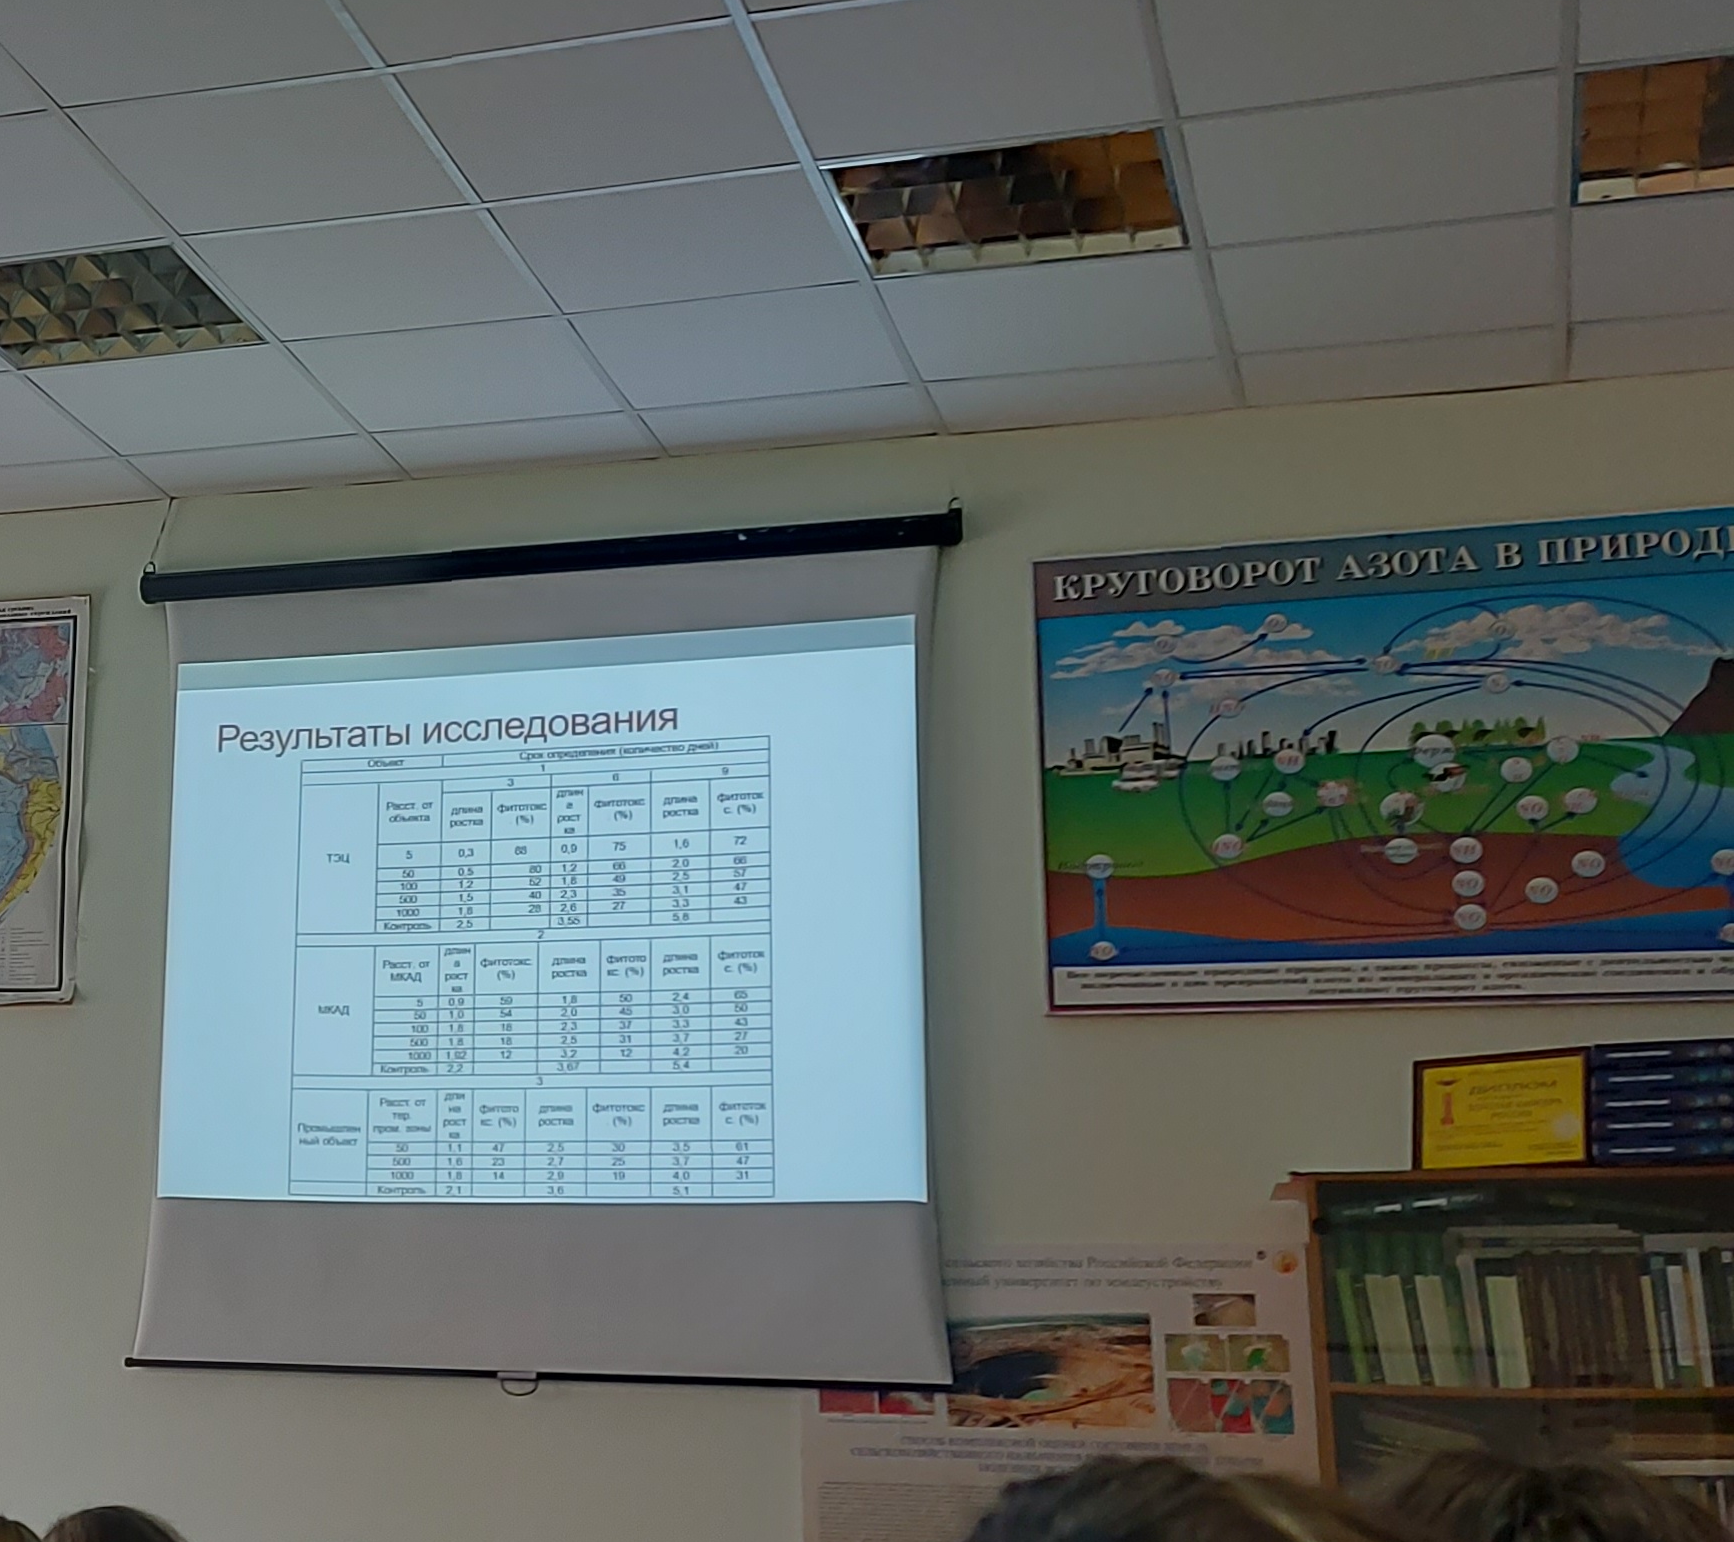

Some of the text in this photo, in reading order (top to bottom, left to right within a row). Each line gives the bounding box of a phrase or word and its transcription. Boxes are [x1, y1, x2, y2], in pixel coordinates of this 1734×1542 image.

[1053, 557, 1323, 602] КРУГОВОРОТ
[1336, 545, 1481, 581] АЗОТА
[1495, 542, 1522, 569] В
[218, 708, 678, 757] Результаты исследования
[507, 779, 514, 787] 3
[421, 801, 433, 809] от
[734, 836, 747, 845] 72
[614, 842, 626, 851] 75
[327, 853, 350, 864] ТЭЦ
[406, 851, 412, 859] 5
[402, 870, 414, 878] 50
[401, 882, 417, 891] 100
[399, 895, 417, 903] 500
[397, 908, 419, 917] 1000
[538, 930, 544, 939] 2
[417, 999, 423, 1007] 5
[318, 1006, 349, 1015] МКАД
[411, 1025, 428, 1033] 100
[410, 1038, 428, 1046] 500
[408, 1052, 431, 1060] 1000
[537, 1077, 543, 1085] 3
[396, 1144, 408, 1152] 50
[392, 1158, 410, 1166] 500
[391, 1171, 414, 1179] 1000
